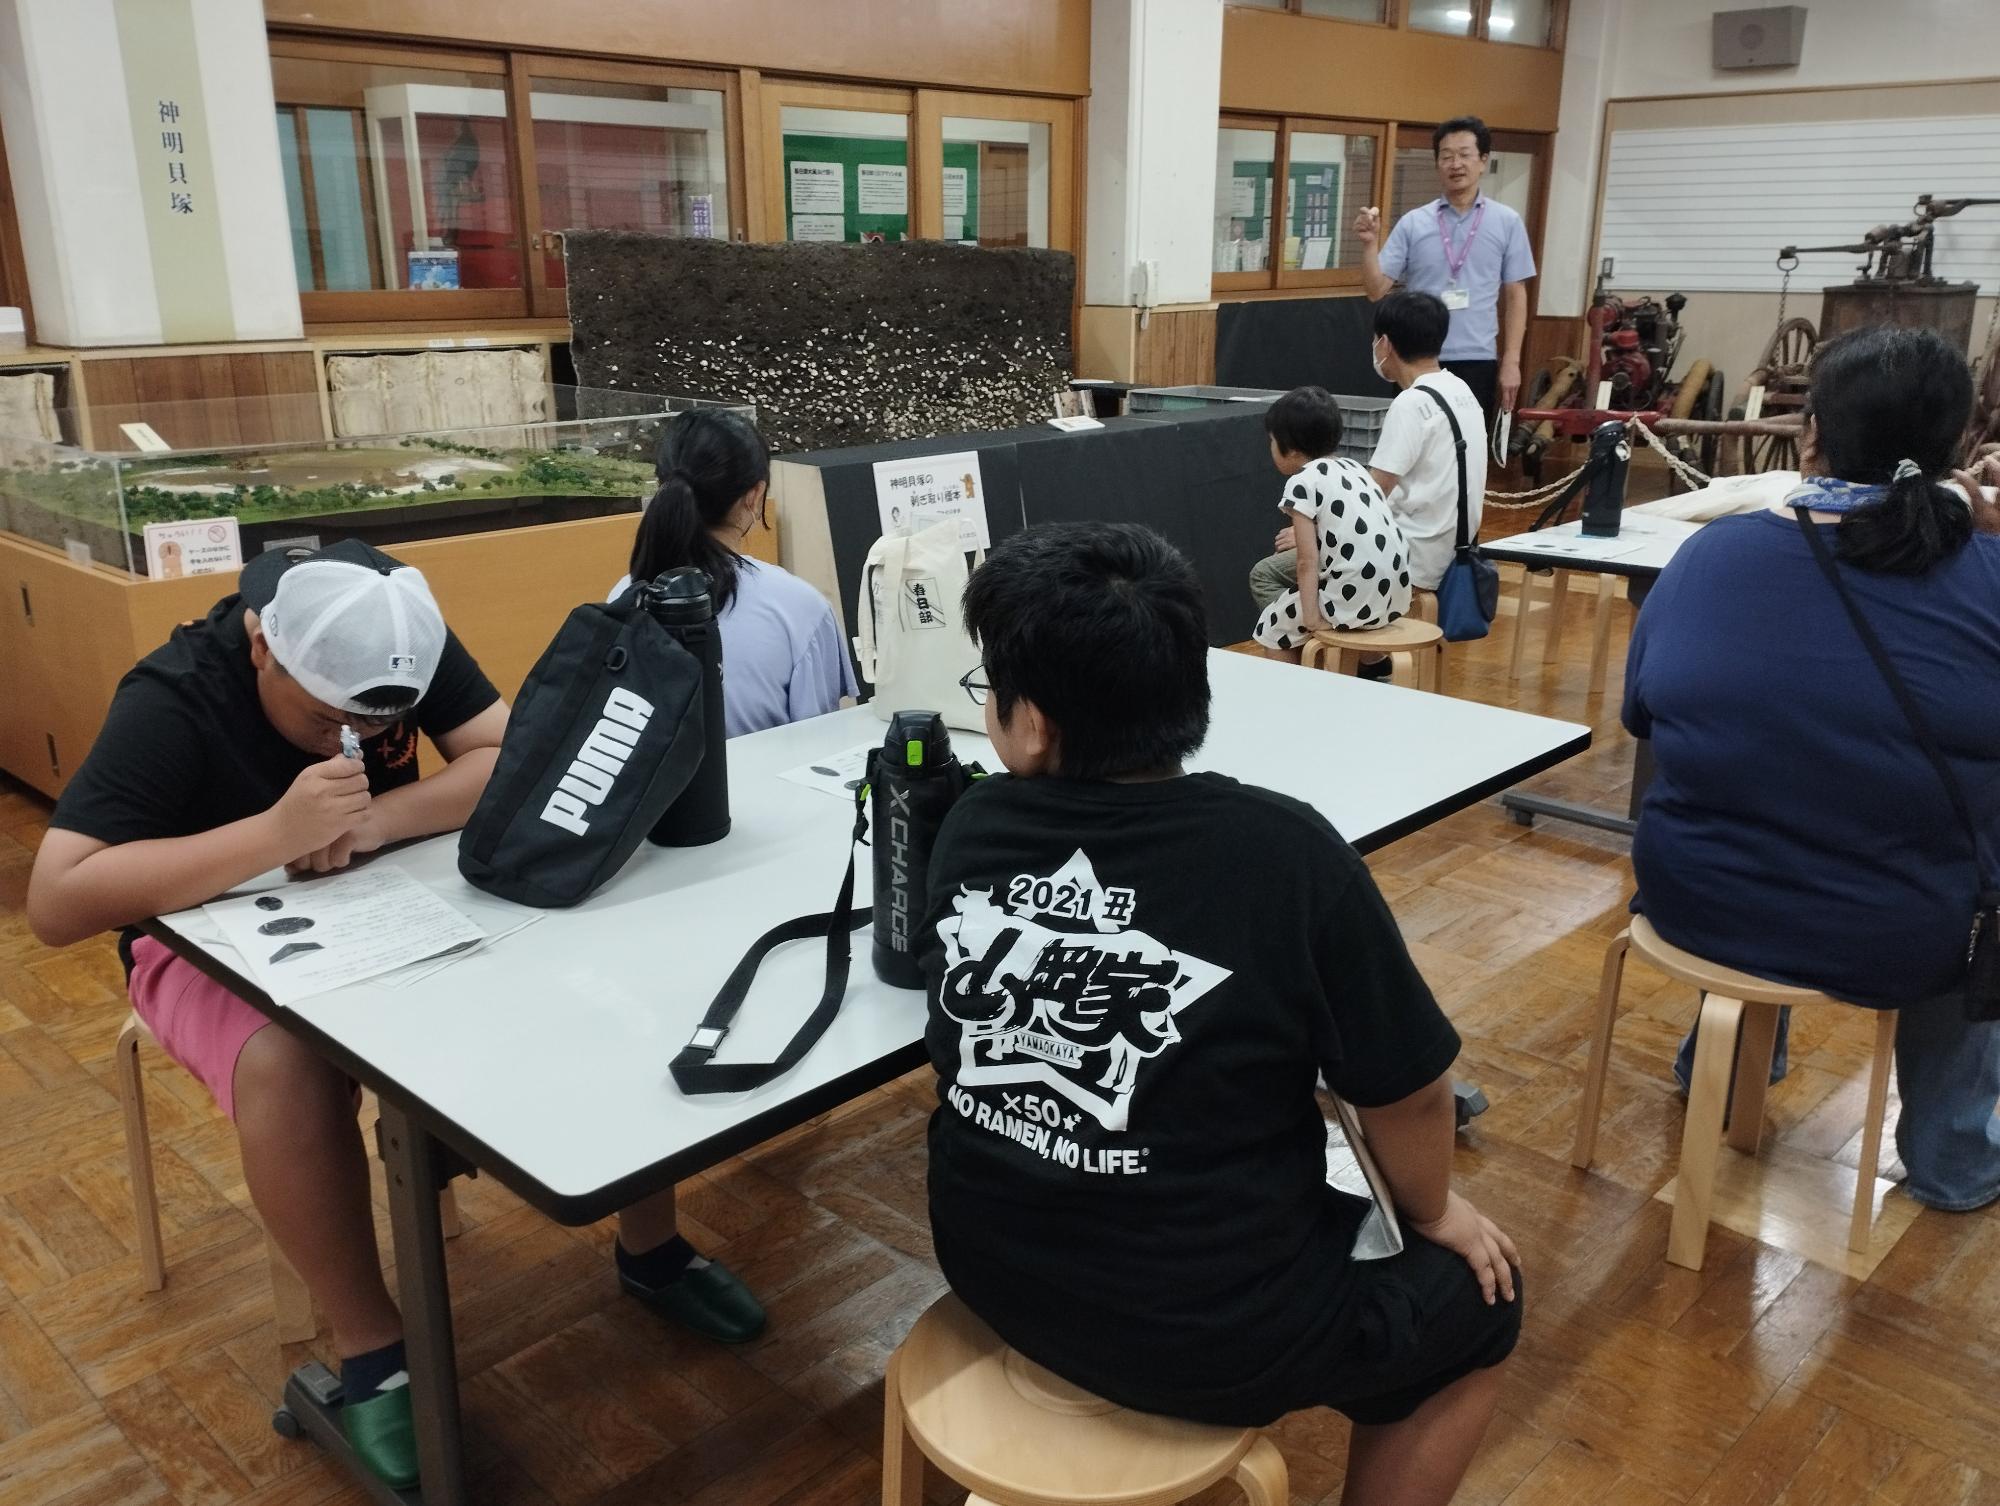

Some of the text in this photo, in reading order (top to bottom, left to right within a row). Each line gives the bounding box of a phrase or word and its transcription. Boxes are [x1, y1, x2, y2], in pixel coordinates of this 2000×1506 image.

[158, 99, 194, 214] 神明貝塚
[889, 474, 934, 490] 神明貝塚の
[540, 687, 655, 836] PUMA
[889, 783, 910, 952] X CHARGE
[1009, 876, 1134, 922] 2021 丑
[1019, 1034, 1075, 1060] YAMAOKAYA
[948, 1084, 975, 1117] NO
[975, 1101, 1051, 1159] RAMEN,
[1052, 1135, 1080, 1169] NO
